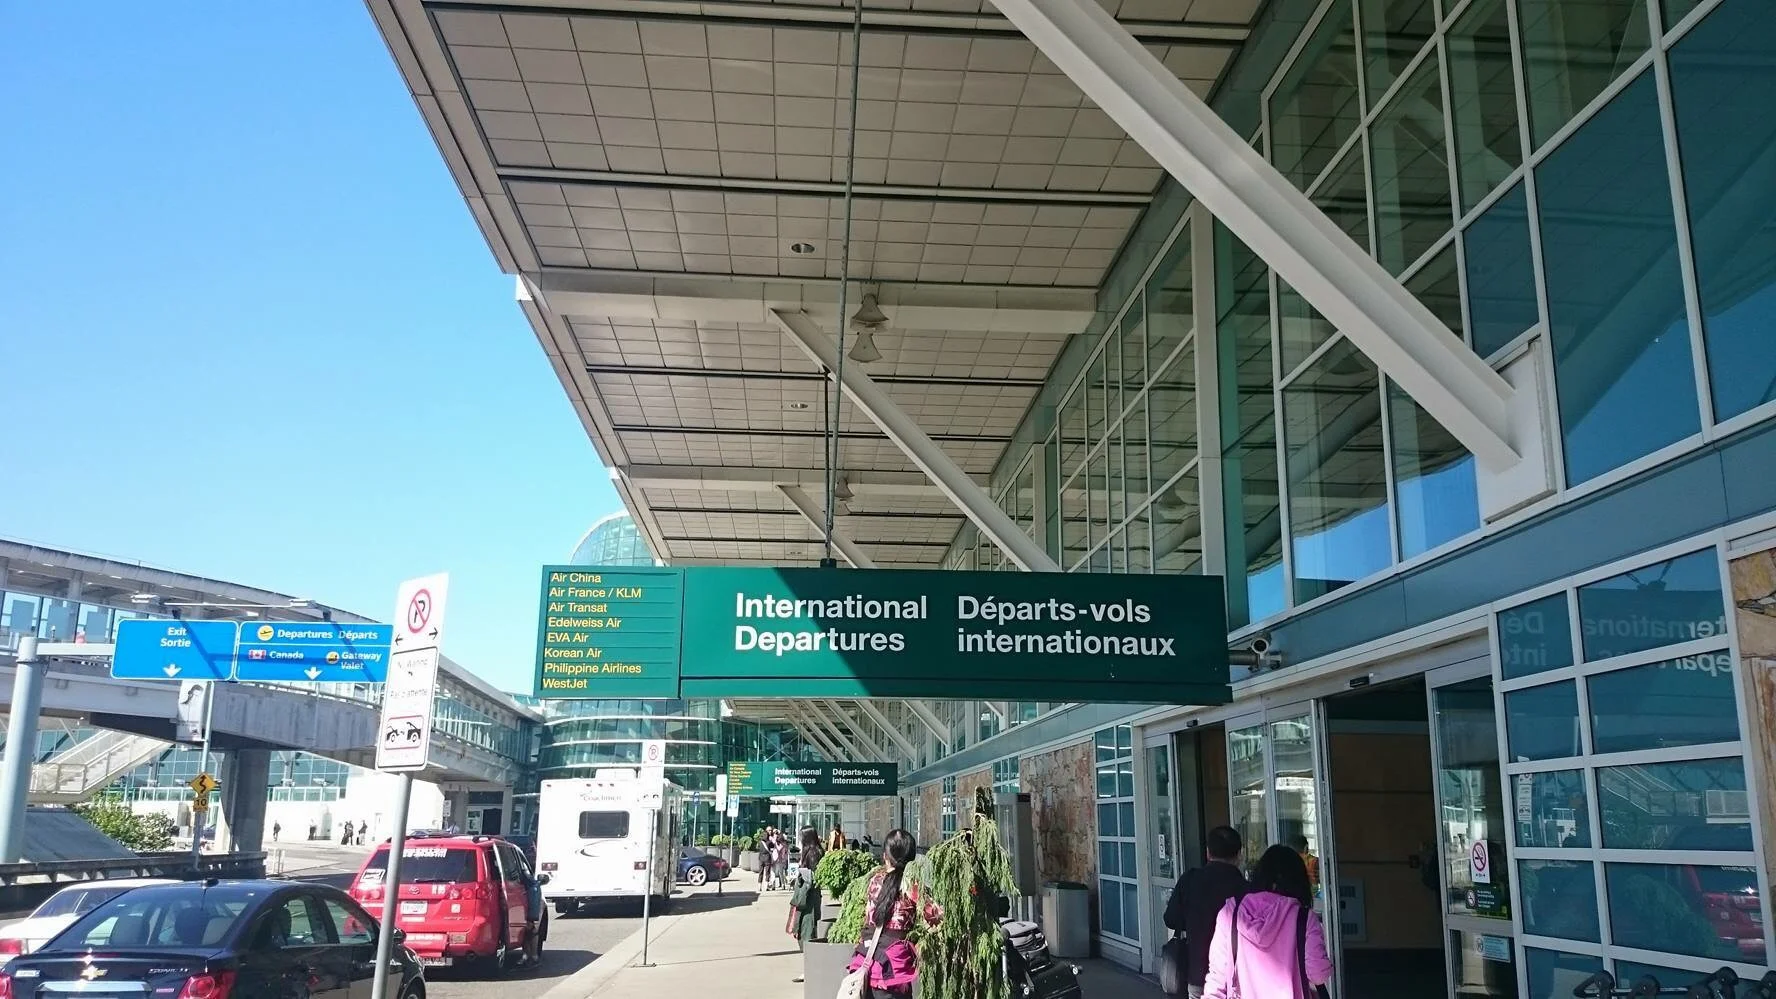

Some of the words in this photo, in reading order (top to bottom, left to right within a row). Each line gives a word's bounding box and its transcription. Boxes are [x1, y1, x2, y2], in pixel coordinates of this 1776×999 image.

[551, 573, 567, 583] Air
[569, 573, 602, 583] China
[549, 587, 565, 597] Air
[568, 588, 606, 597] France
[608, 588, 613, 597] /
[616, 588, 642, 598] KLM
[548, 603, 565, 612] Air
[568, 603, 608, 613] Transat
[736, 592, 927, 619] International
[958, 595, 1151, 625] Départs-vols
[548, 617, 604, 627] Edelweiss
[606, 618, 622, 628] Air
[167, 627, 188, 636] Exit
[277, 629, 333, 640] Departures
[338, 630, 379, 641] Départs
[547, 632, 571, 643] EVA
[573, 633, 589, 643] Air
[735, 625, 905, 656] Departures
[958, 627, 1176, 656] internationaux
[160, 638, 191, 648] Sortie
[269, 650, 304, 660] Canada
[342, 651, 382, 662] Gateway
[544, 648, 584, 658] Korean
[586, 648, 602, 658] Air
[544, 663, 599, 675] Philippine
[601, 663, 642, 673] Airlines
[542, 678, 588, 689] WestJet
[775, 767, 822, 776] International
[832, 767, 880, 777] Départs-vols
[774, 776, 817, 785] Departures
[832, 776, 885, 785] internationaux
[195, 798, 207, 807] 10
